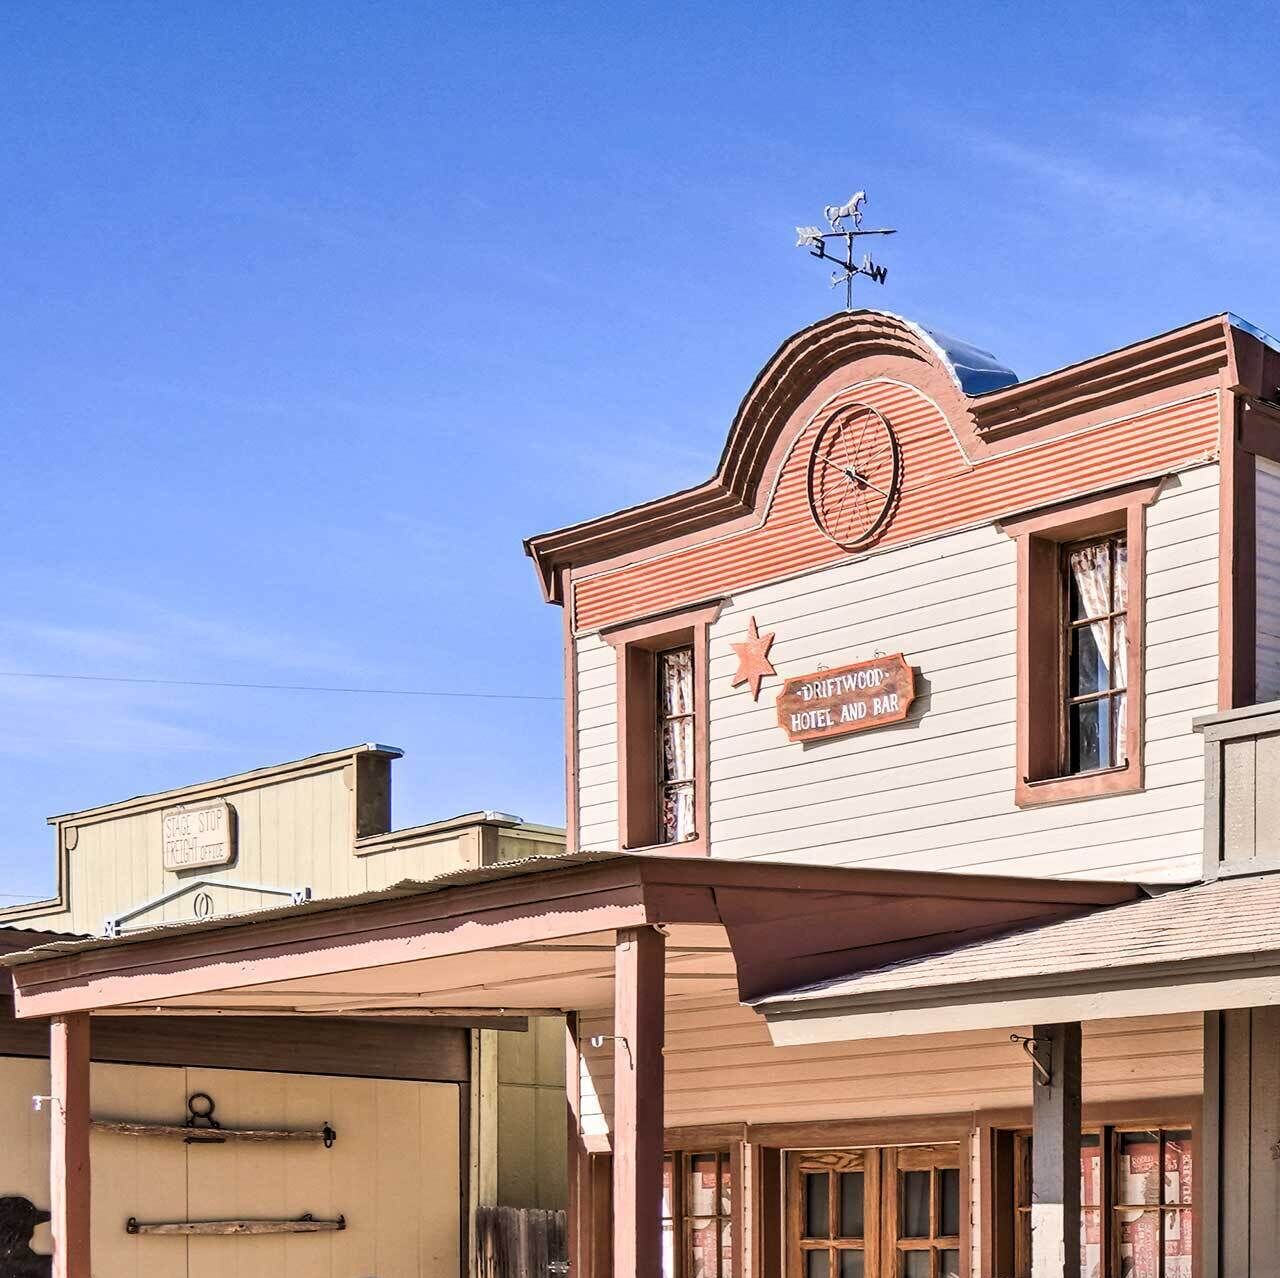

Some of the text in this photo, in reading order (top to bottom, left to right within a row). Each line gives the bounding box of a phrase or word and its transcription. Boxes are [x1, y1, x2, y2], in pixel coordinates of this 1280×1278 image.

[801, 668, 884, 701] DRIFTWOOD
[790, 693, 900, 732] HOTEL AND BAR
[165, 808, 223, 838] STAGE STOP
[166, 836, 225, 866] FREIGHT OFFICE
